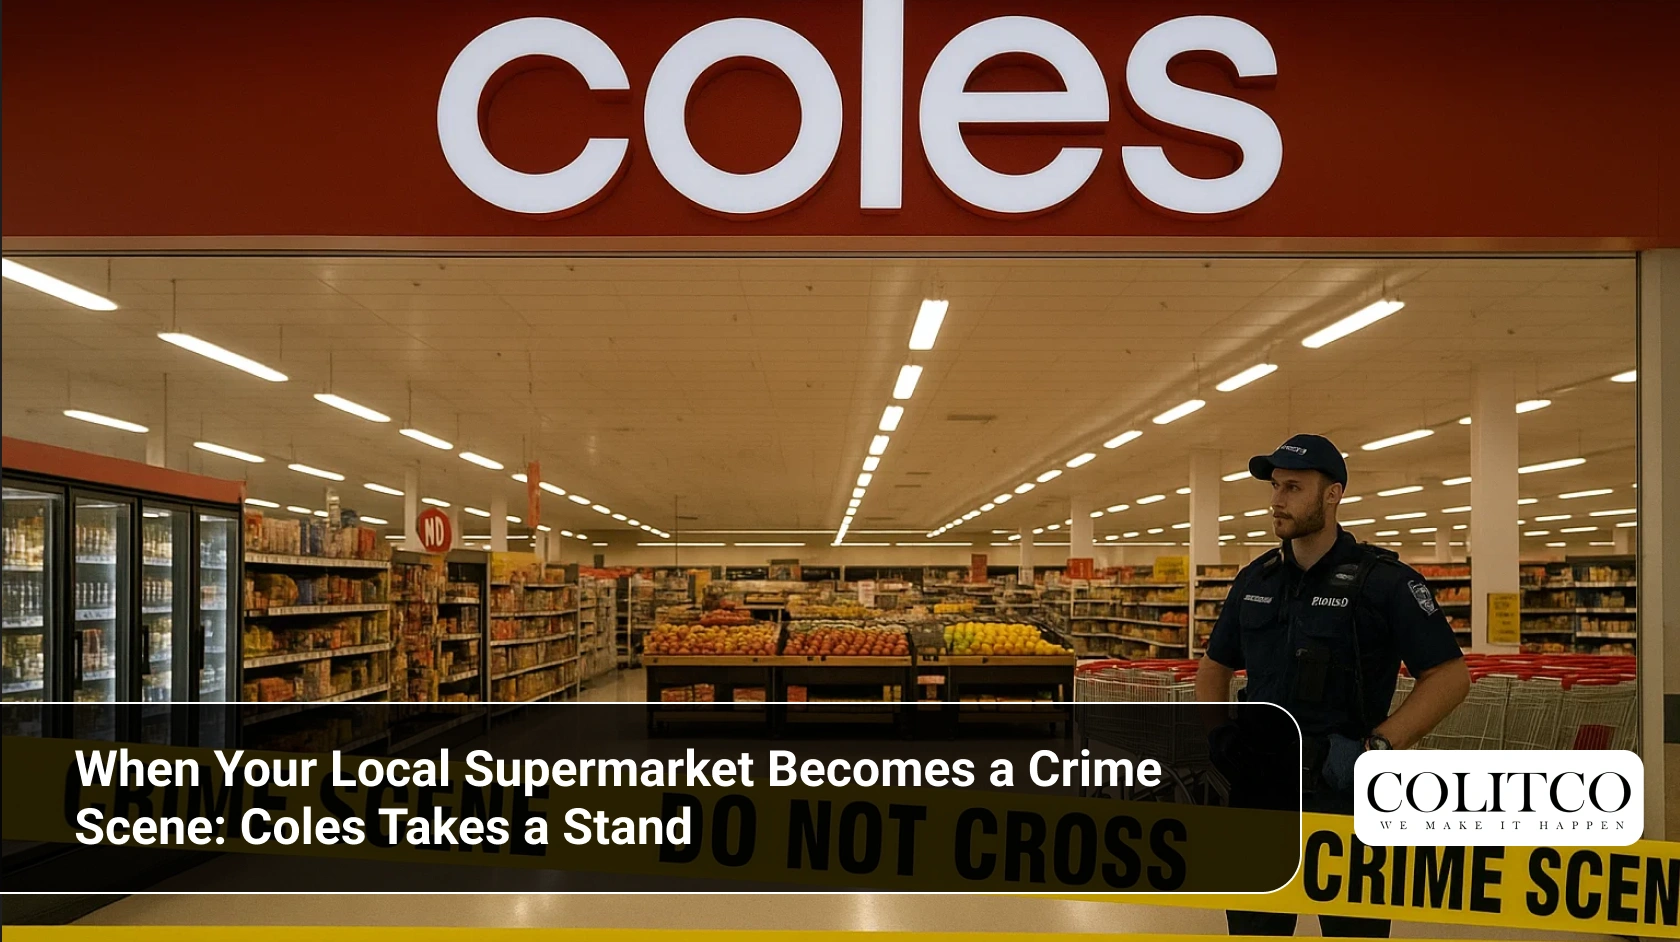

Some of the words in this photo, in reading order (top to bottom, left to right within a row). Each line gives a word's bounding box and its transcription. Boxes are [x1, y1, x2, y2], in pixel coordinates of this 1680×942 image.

[437, 0, 1283, 214] coles
[658, 792, 757, 867] DO
[786, 797, 927, 877] NOT
[953, 806, 1188, 891] CROSS
[1303, 830, 1505, 914] CRIME
[1526, 846, 1680, 926] SCEN
